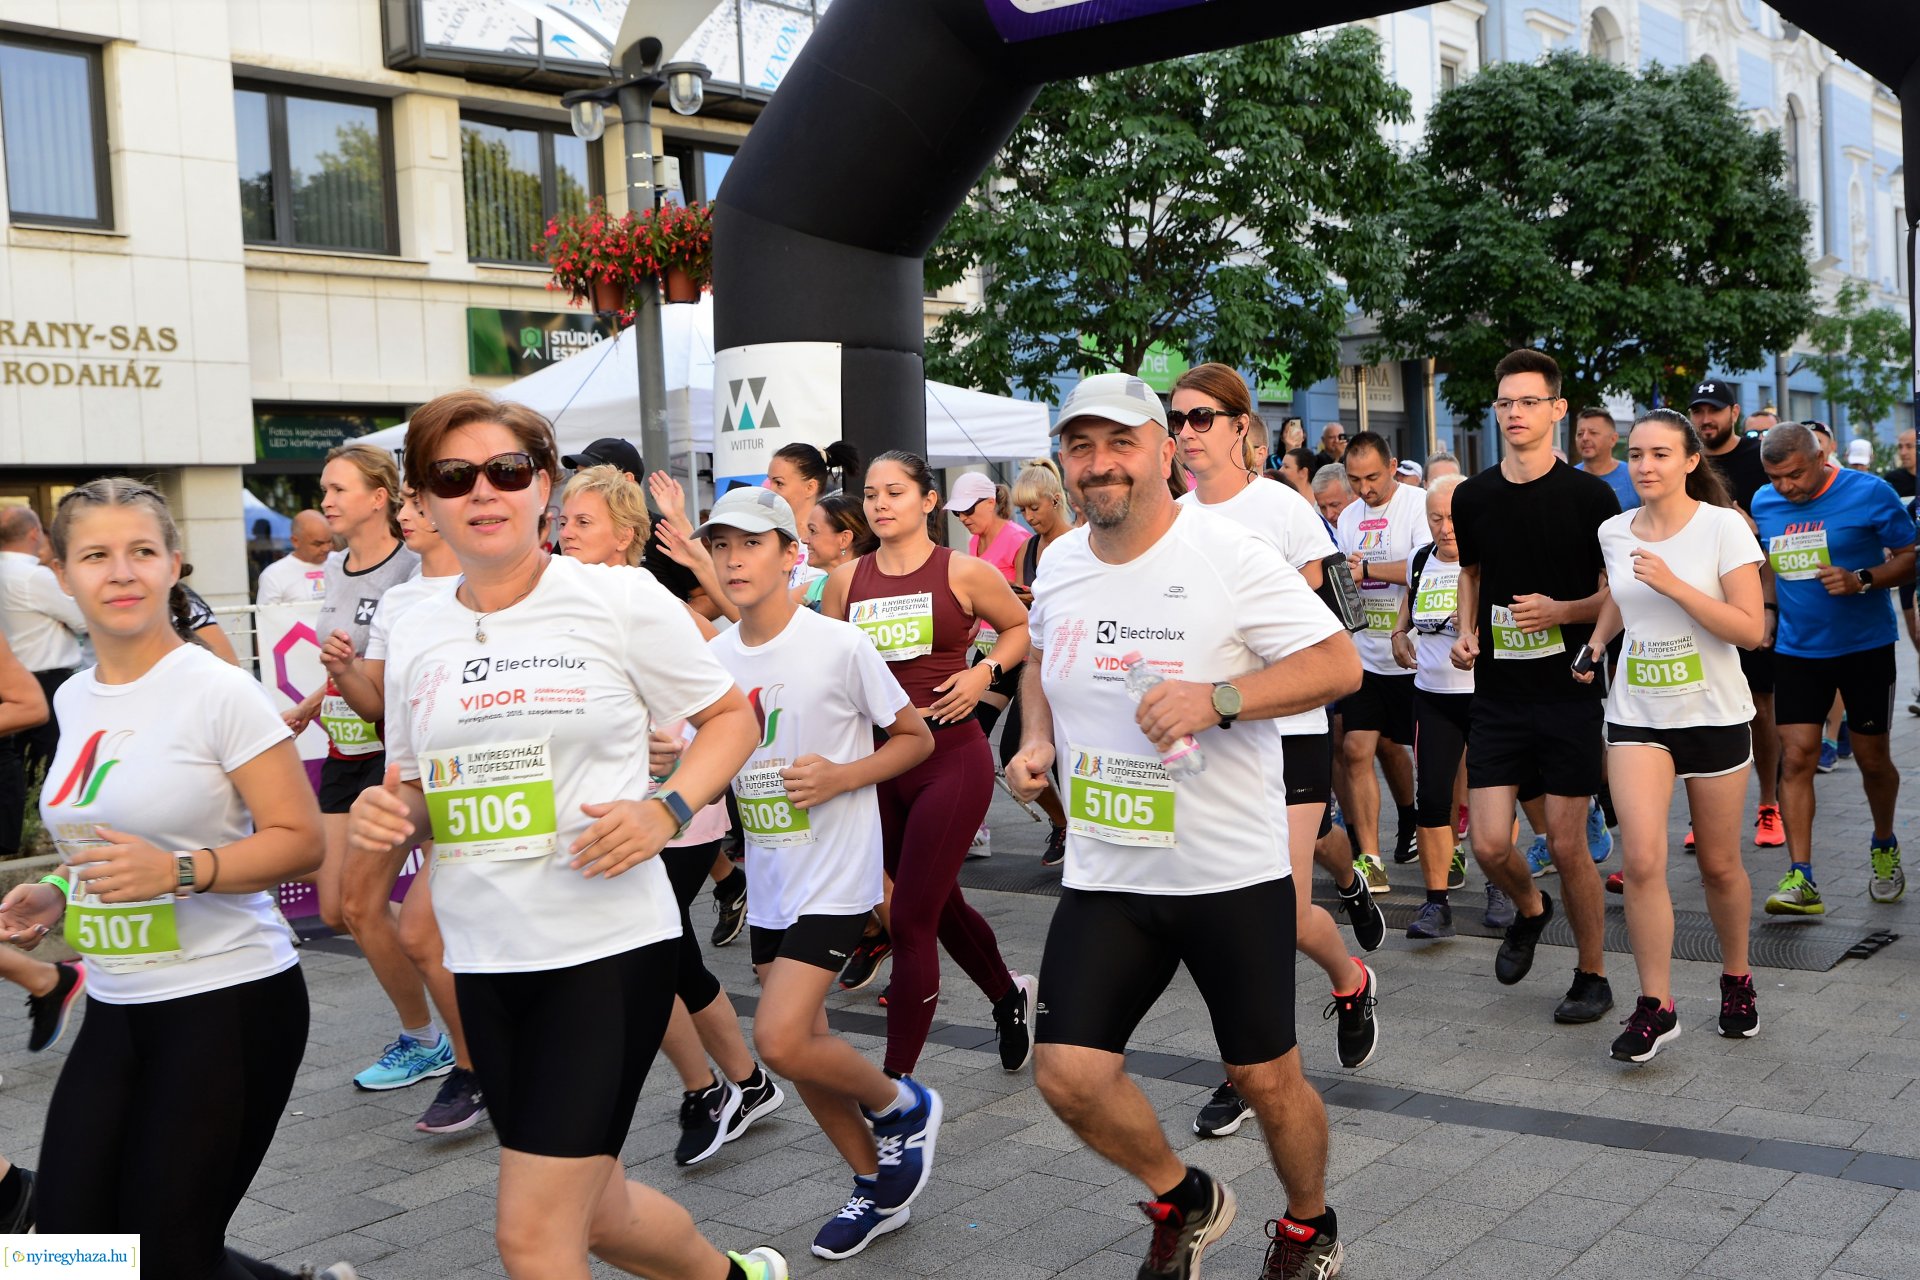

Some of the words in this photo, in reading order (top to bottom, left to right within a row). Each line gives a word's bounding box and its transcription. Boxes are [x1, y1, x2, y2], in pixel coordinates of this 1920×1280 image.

[550, 328, 603, 347] STÚDIÓ
[3, 359, 162, 388] RODAHÁZ
[1257, 389, 1288, 398] OPTIKA
[731, 438, 764, 451] WITTUR
[1777, 551, 1820, 571] 5084
[1424, 592, 1457, 609] 505
[1366, 613, 1391, 628] 094
[864, 621, 920, 647] 5095
[1120, 627, 1185, 640] Electrolux
[1502, 630, 1549, 648] 5019
[496, 655, 587, 673] Electrolux
[1094, 656, 1131, 672] VIDO
[1636, 662, 1688, 684] 5018
[459, 689, 526, 711] VIDOR
[327, 721, 368, 742] 5132
[468, 757, 546, 775] FUTÓFESZTIVÁL
[745, 780, 785, 790] FUTÓFESZT
[447, 791, 532, 837] 5106
[1084, 786, 1155, 825] 5105
[740, 801, 793, 830] 5108
[79, 912, 153, 949] 5107
